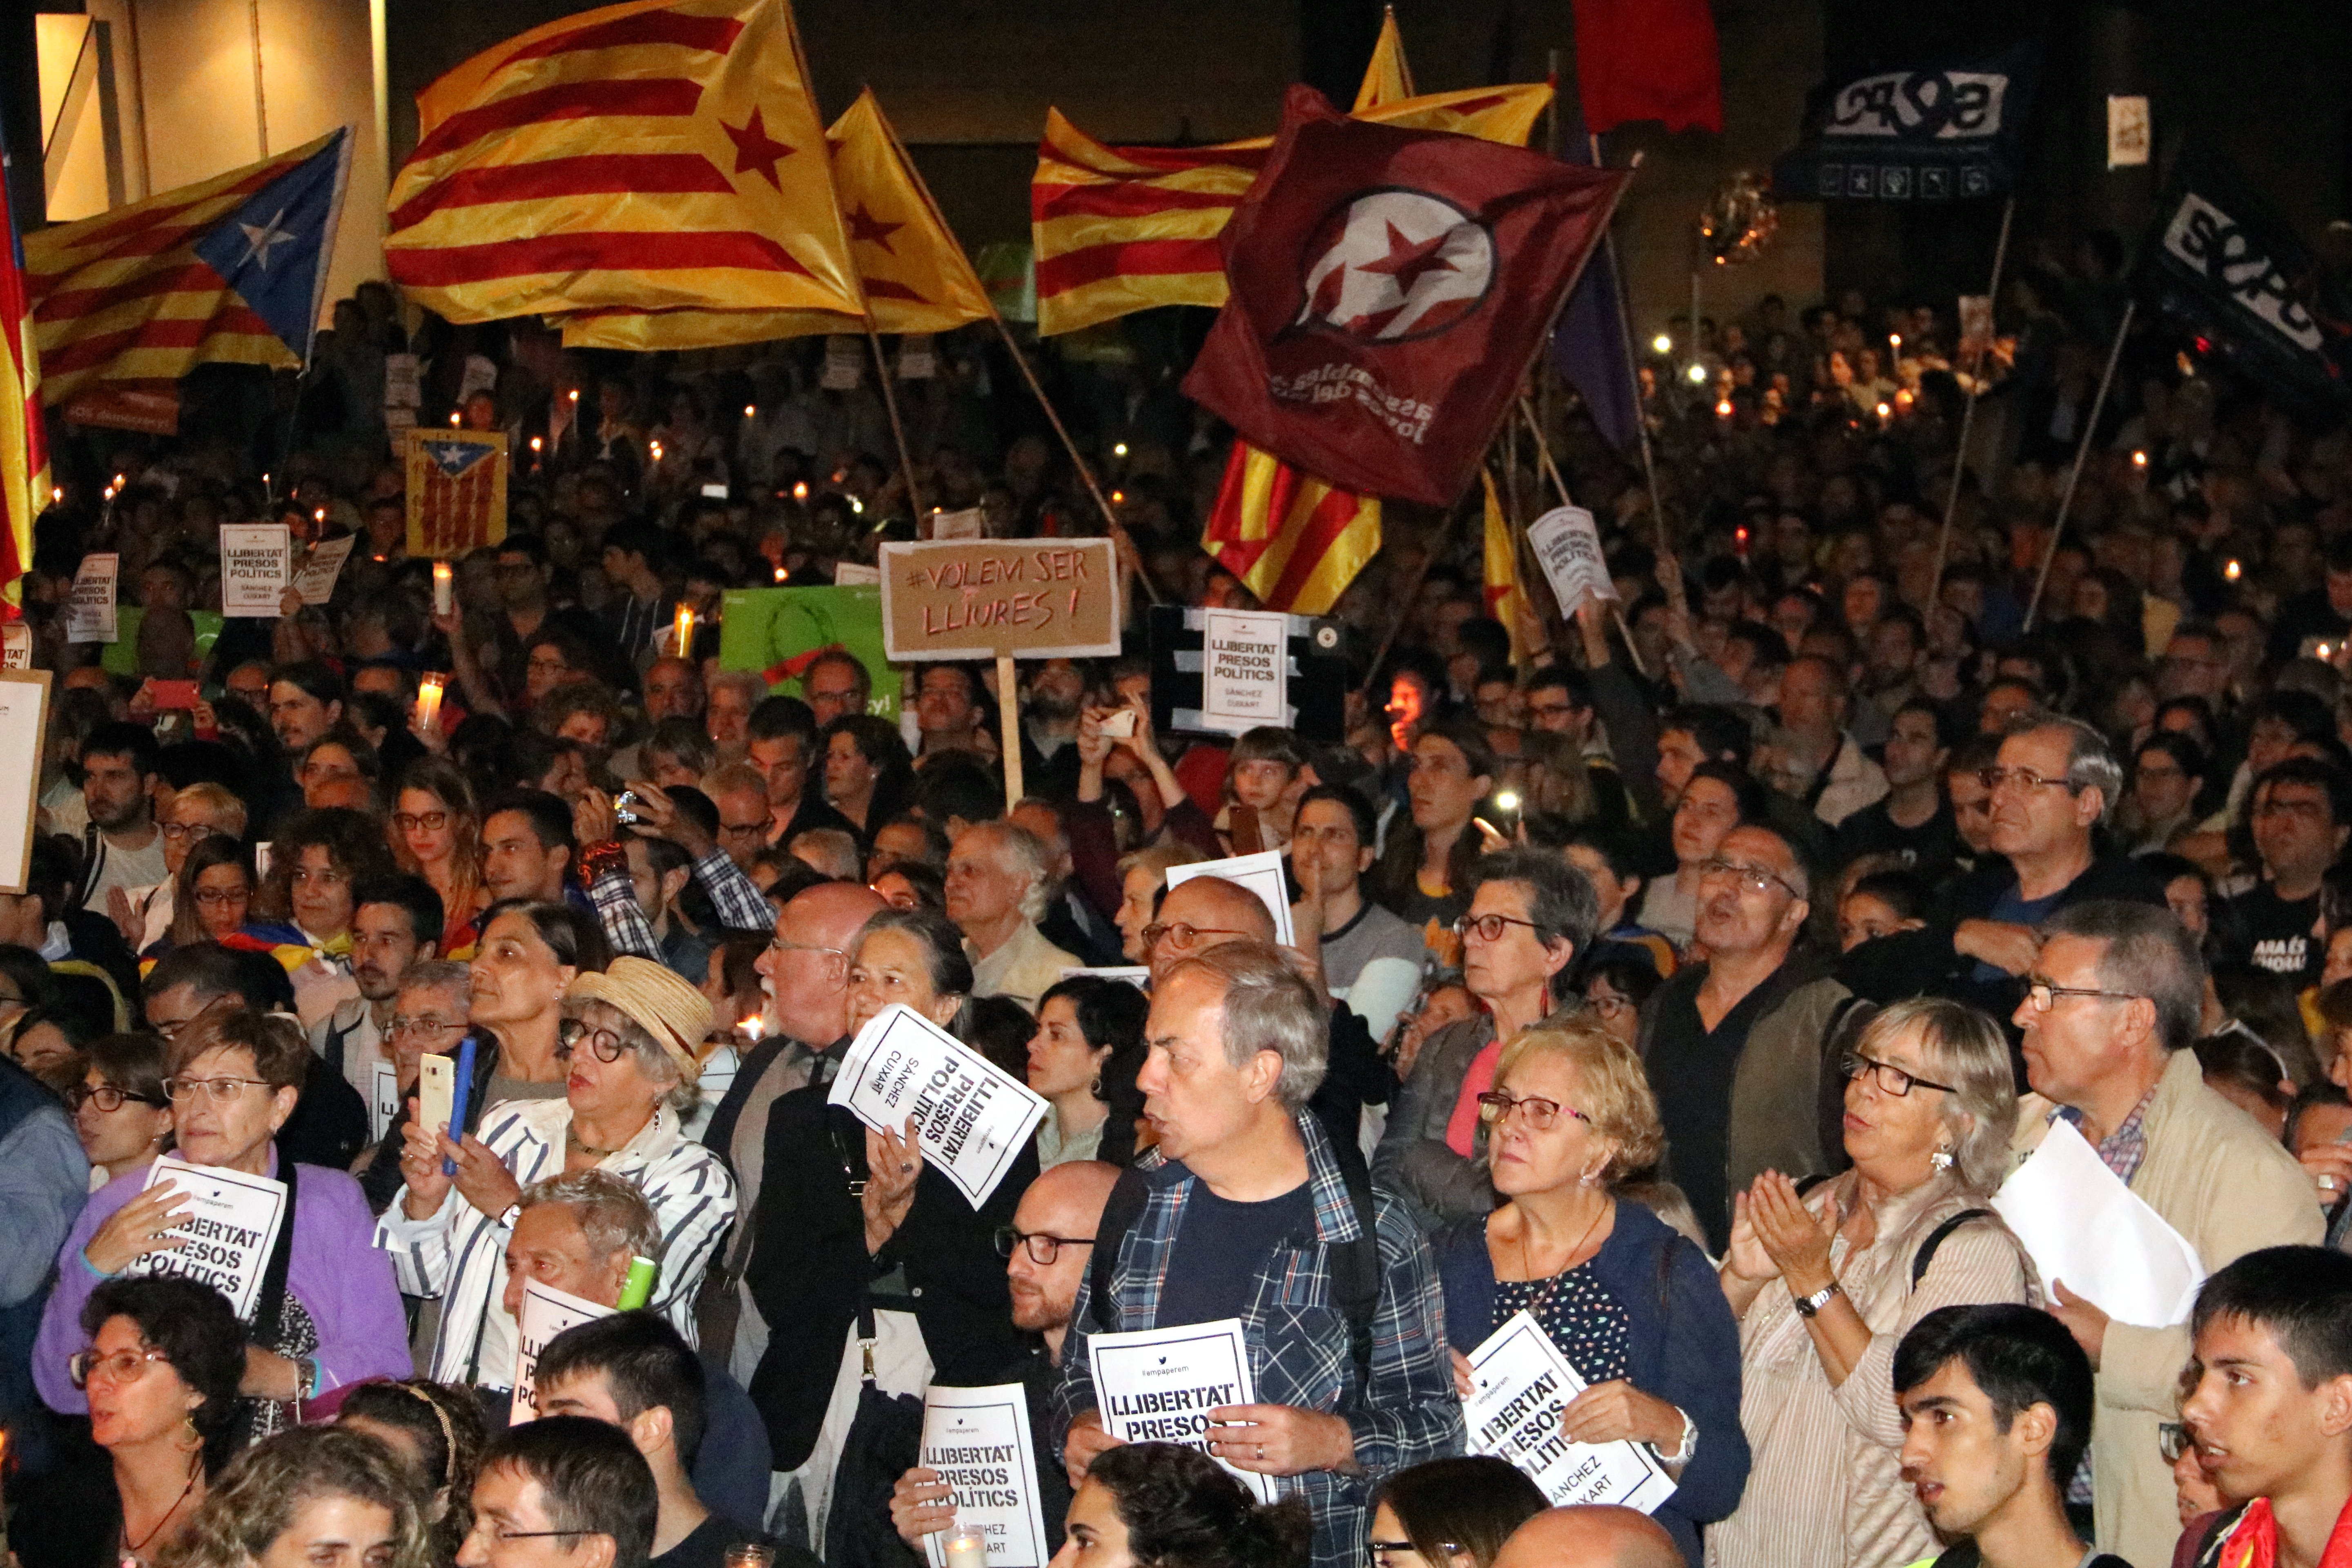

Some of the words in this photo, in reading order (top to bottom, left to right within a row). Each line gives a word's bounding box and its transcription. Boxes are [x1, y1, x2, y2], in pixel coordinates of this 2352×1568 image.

[227, 549, 283, 557] LLIBERTAT
[234, 559, 278, 567] PRESOS
[906, 557, 1023, 589] #VOLEM
[1034, 551, 1087, 581] SER
[1212, 639, 1277, 654] LLIBERTAT
[1218, 653, 1271, 668] PRESOS
[871, 1050, 901, 1096] CUIXART
[925, 1074, 974, 1143] PRESOS
[941, 1076, 999, 1165] LLIBERTAT
[1142, 1366, 1189, 1376] #empaperem
[1111, 1383, 1234, 1416] LLIBERTAT
[926, 1444, 1014, 1464] LLIBERTAT
